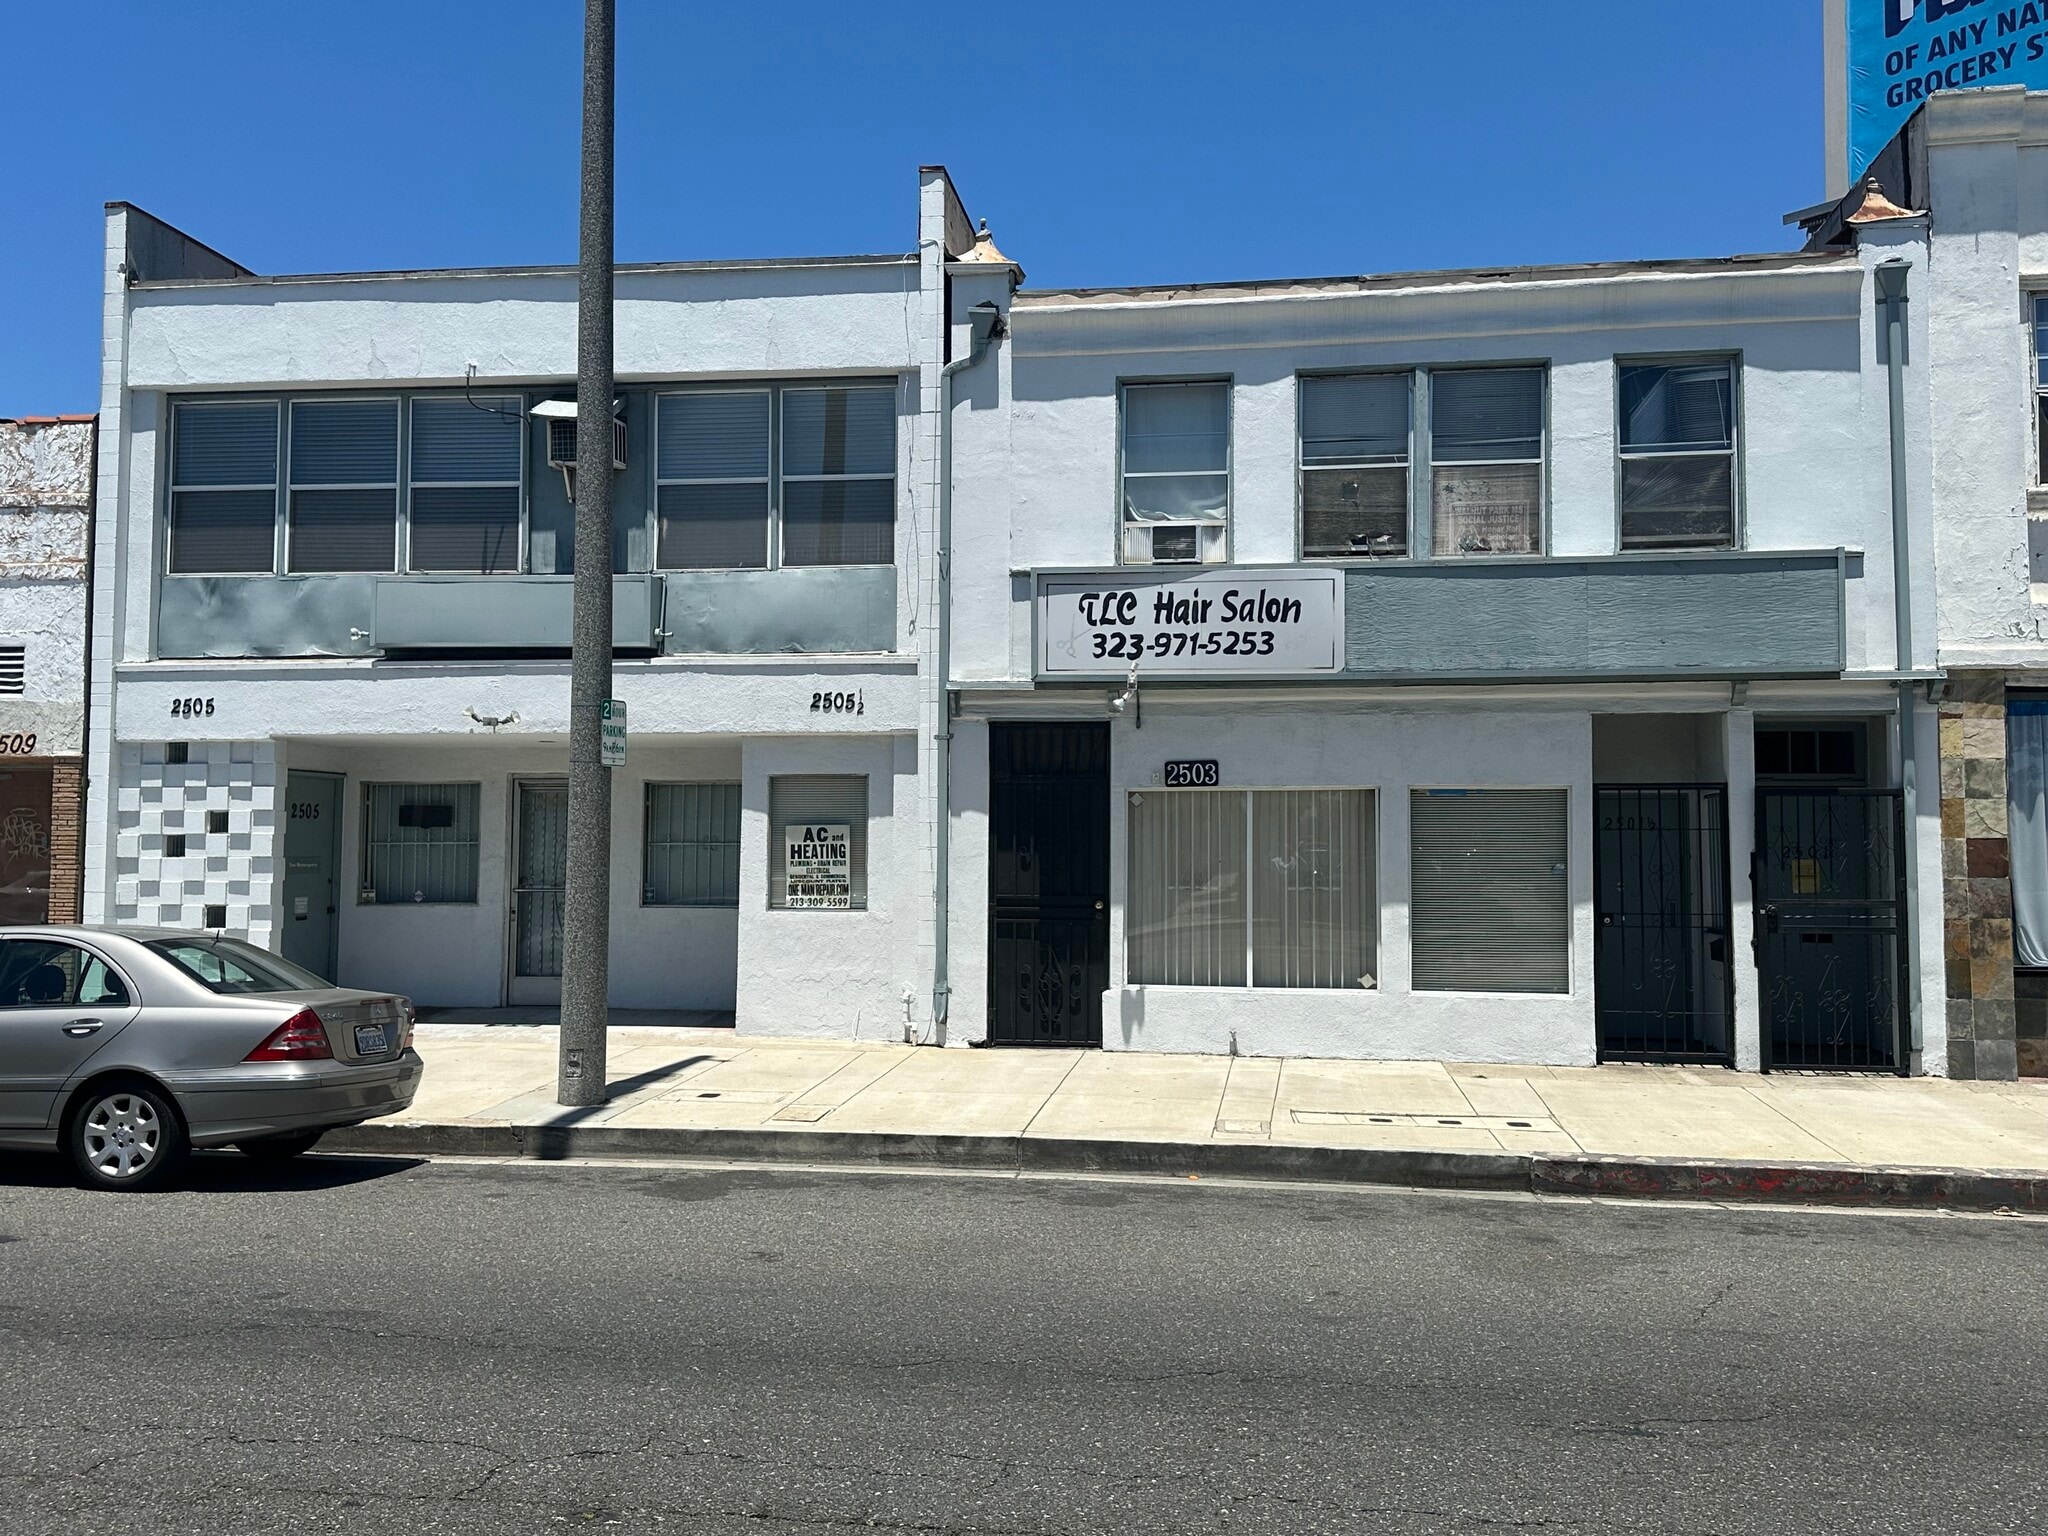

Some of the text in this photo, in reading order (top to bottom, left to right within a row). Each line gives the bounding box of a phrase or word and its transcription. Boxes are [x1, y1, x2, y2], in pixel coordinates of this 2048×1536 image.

[1885, 44, 1919, 76] OF
[1927, 18, 1988, 63] ANY
[1886, 31, 2048, 108] GROCERY S
[1458, 514, 1520, 524] SOCIAL JUSTICE
[1078, 588, 1302, 627] TLC Hair Salon
[1092, 630, 1275, 660] 323-971-5253
[170, 697, 215, 716] 2505
[603, 702, 610, 717] 2
[603, 724, 625, 738] PARKING
[0, 734, 37, 754] 509
[1167, 763, 1217, 785] 2503
[291, 802, 320, 819] 2505
[803, 827, 844, 842] AC and
[790, 844, 847, 859] HEATING
[788, 884, 800, 896] ONE
[801, 884, 815, 896] MAN
[790, 897, 848, 907] 213-309-5599
